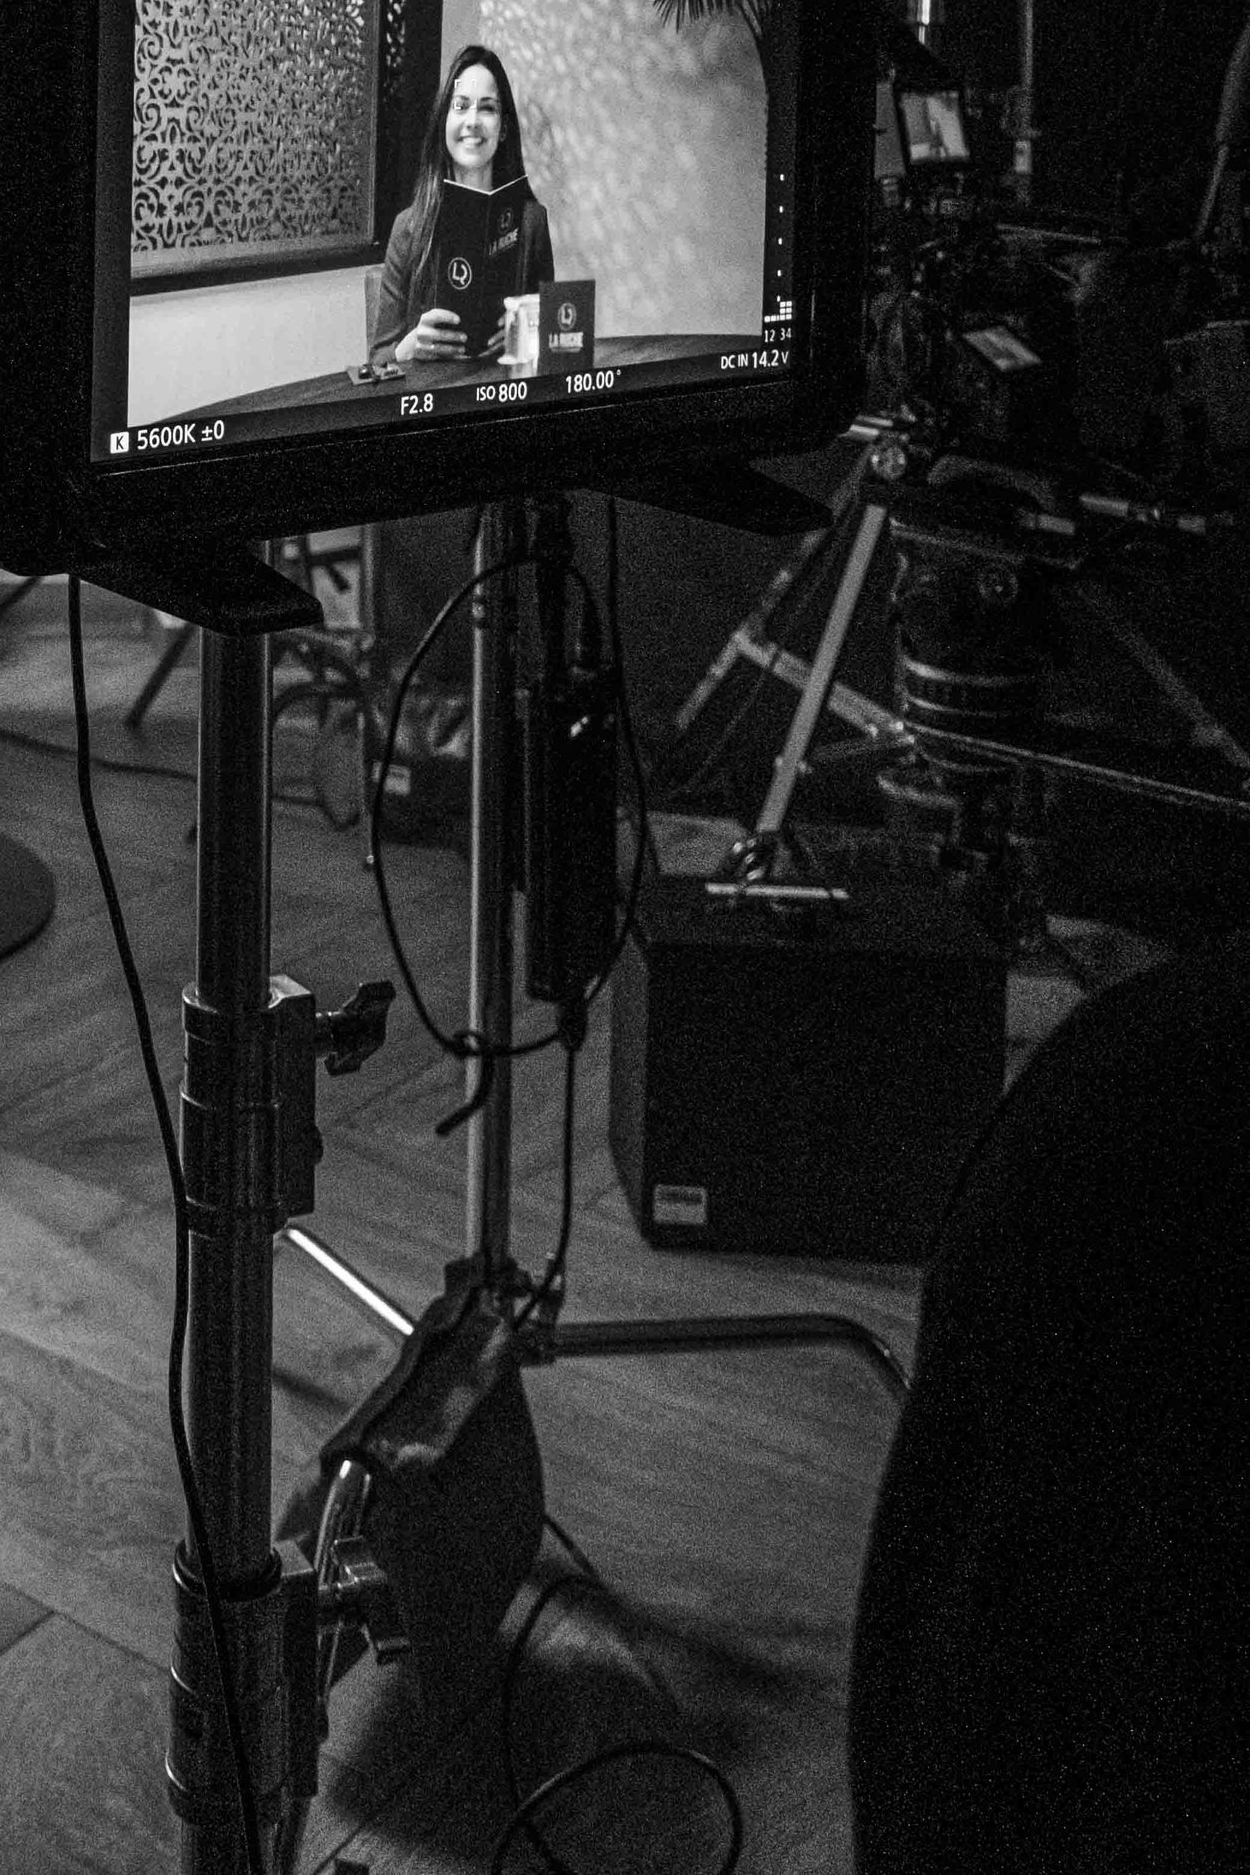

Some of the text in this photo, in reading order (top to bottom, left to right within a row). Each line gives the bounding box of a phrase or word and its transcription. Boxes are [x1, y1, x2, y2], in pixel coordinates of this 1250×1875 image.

[720, 354, 736, 370] DC
[737, 353, 749, 368] IN
[400, 392, 434, 416] F2.8
[475, 381, 528, 404] ISO 800
[137, 422, 196, 451] 5600K
[201, 419, 225, 443] ±0
